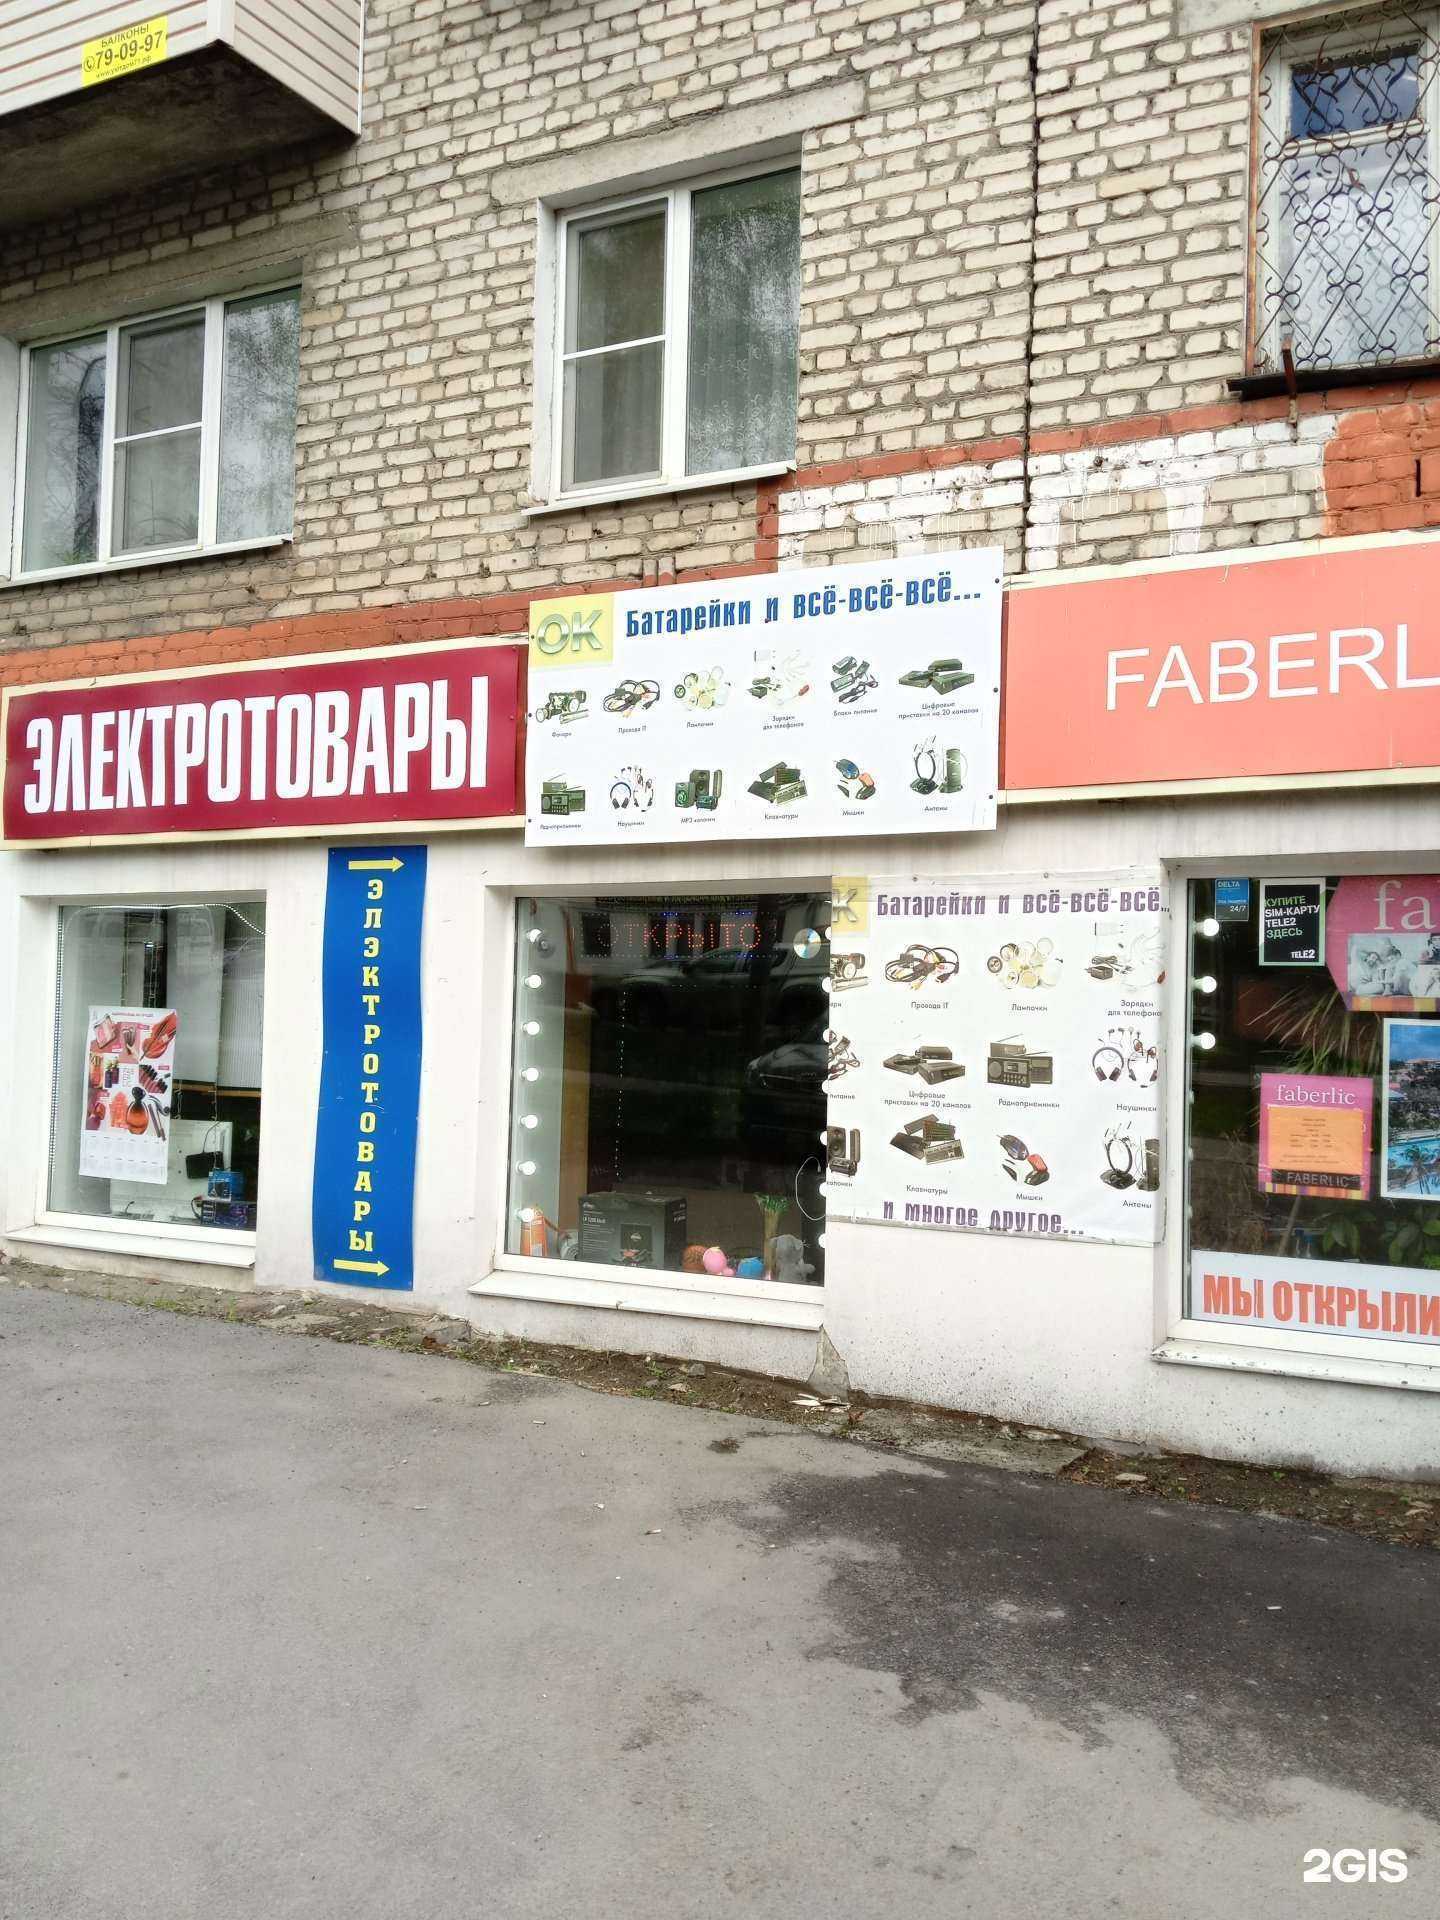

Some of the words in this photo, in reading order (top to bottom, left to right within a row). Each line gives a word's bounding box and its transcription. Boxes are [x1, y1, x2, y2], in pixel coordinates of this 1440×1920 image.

[101, 24, 149, 48] БАЛКОНЫ
[96, 30, 163, 69] 79-09-97
[626, 599, 751, 637] Батарейки
[765, 597, 778, 623] и
[1105, 623, 1440, 711] FABERL
[942, 708, 951, 717] 20
[24, 676, 489, 814] ЭЛЕКТРОТОВАРЫ
[877, 892, 986, 919] Батарейки
[998, 894, 1010, 914] и
[1264, 895, 1306, 907] КУПИТЕ
[1373, 879, 1438, 930] fa
[1230, 905, 1246, 913] 24/7
[1265, 904, 1320, 918] SIM-КАРТУ
[1265, 917, 1297, 928] TELE2
[598, 923, 761, 948] ОТКРЫТО
[1266, 928, 1303, 940] ЗДЕСЬ
[1291, 949, 1316, 959] TELE2
[911, 1001, 941, 1010] Провода
[1011, 1003, 1048, 1012] Лампочки
[1107, 1009, 1121, 1018] для
[348, 878, 384, 1252] ЭЛЭКТРОТОВАРЫ
[909, 1090, 946, 1100] Цифровые
[1275, 1084, 1356, 1105] faberlic
[884, 1099, 919, 1107] приставки
[931, 1100, 941, 1108] 20
[1116, 1103, 1157, 1113] Наушники
[1287, 1172, 1348, 1187] FABERLIC
[906, 1185, 948, 1196] Клавиатуры
[1016, 1192, 1043, 1201] Мышки
[1122, 1200, 1152, 1209] Антены
[883, 1200, 894, 1220] и
[905, 1202, 978, 1227] многое
[1203, 1274, 1264, 1319] МЫ
[1272, 1280, 1440, 1337] ОТКРЫЛИ
